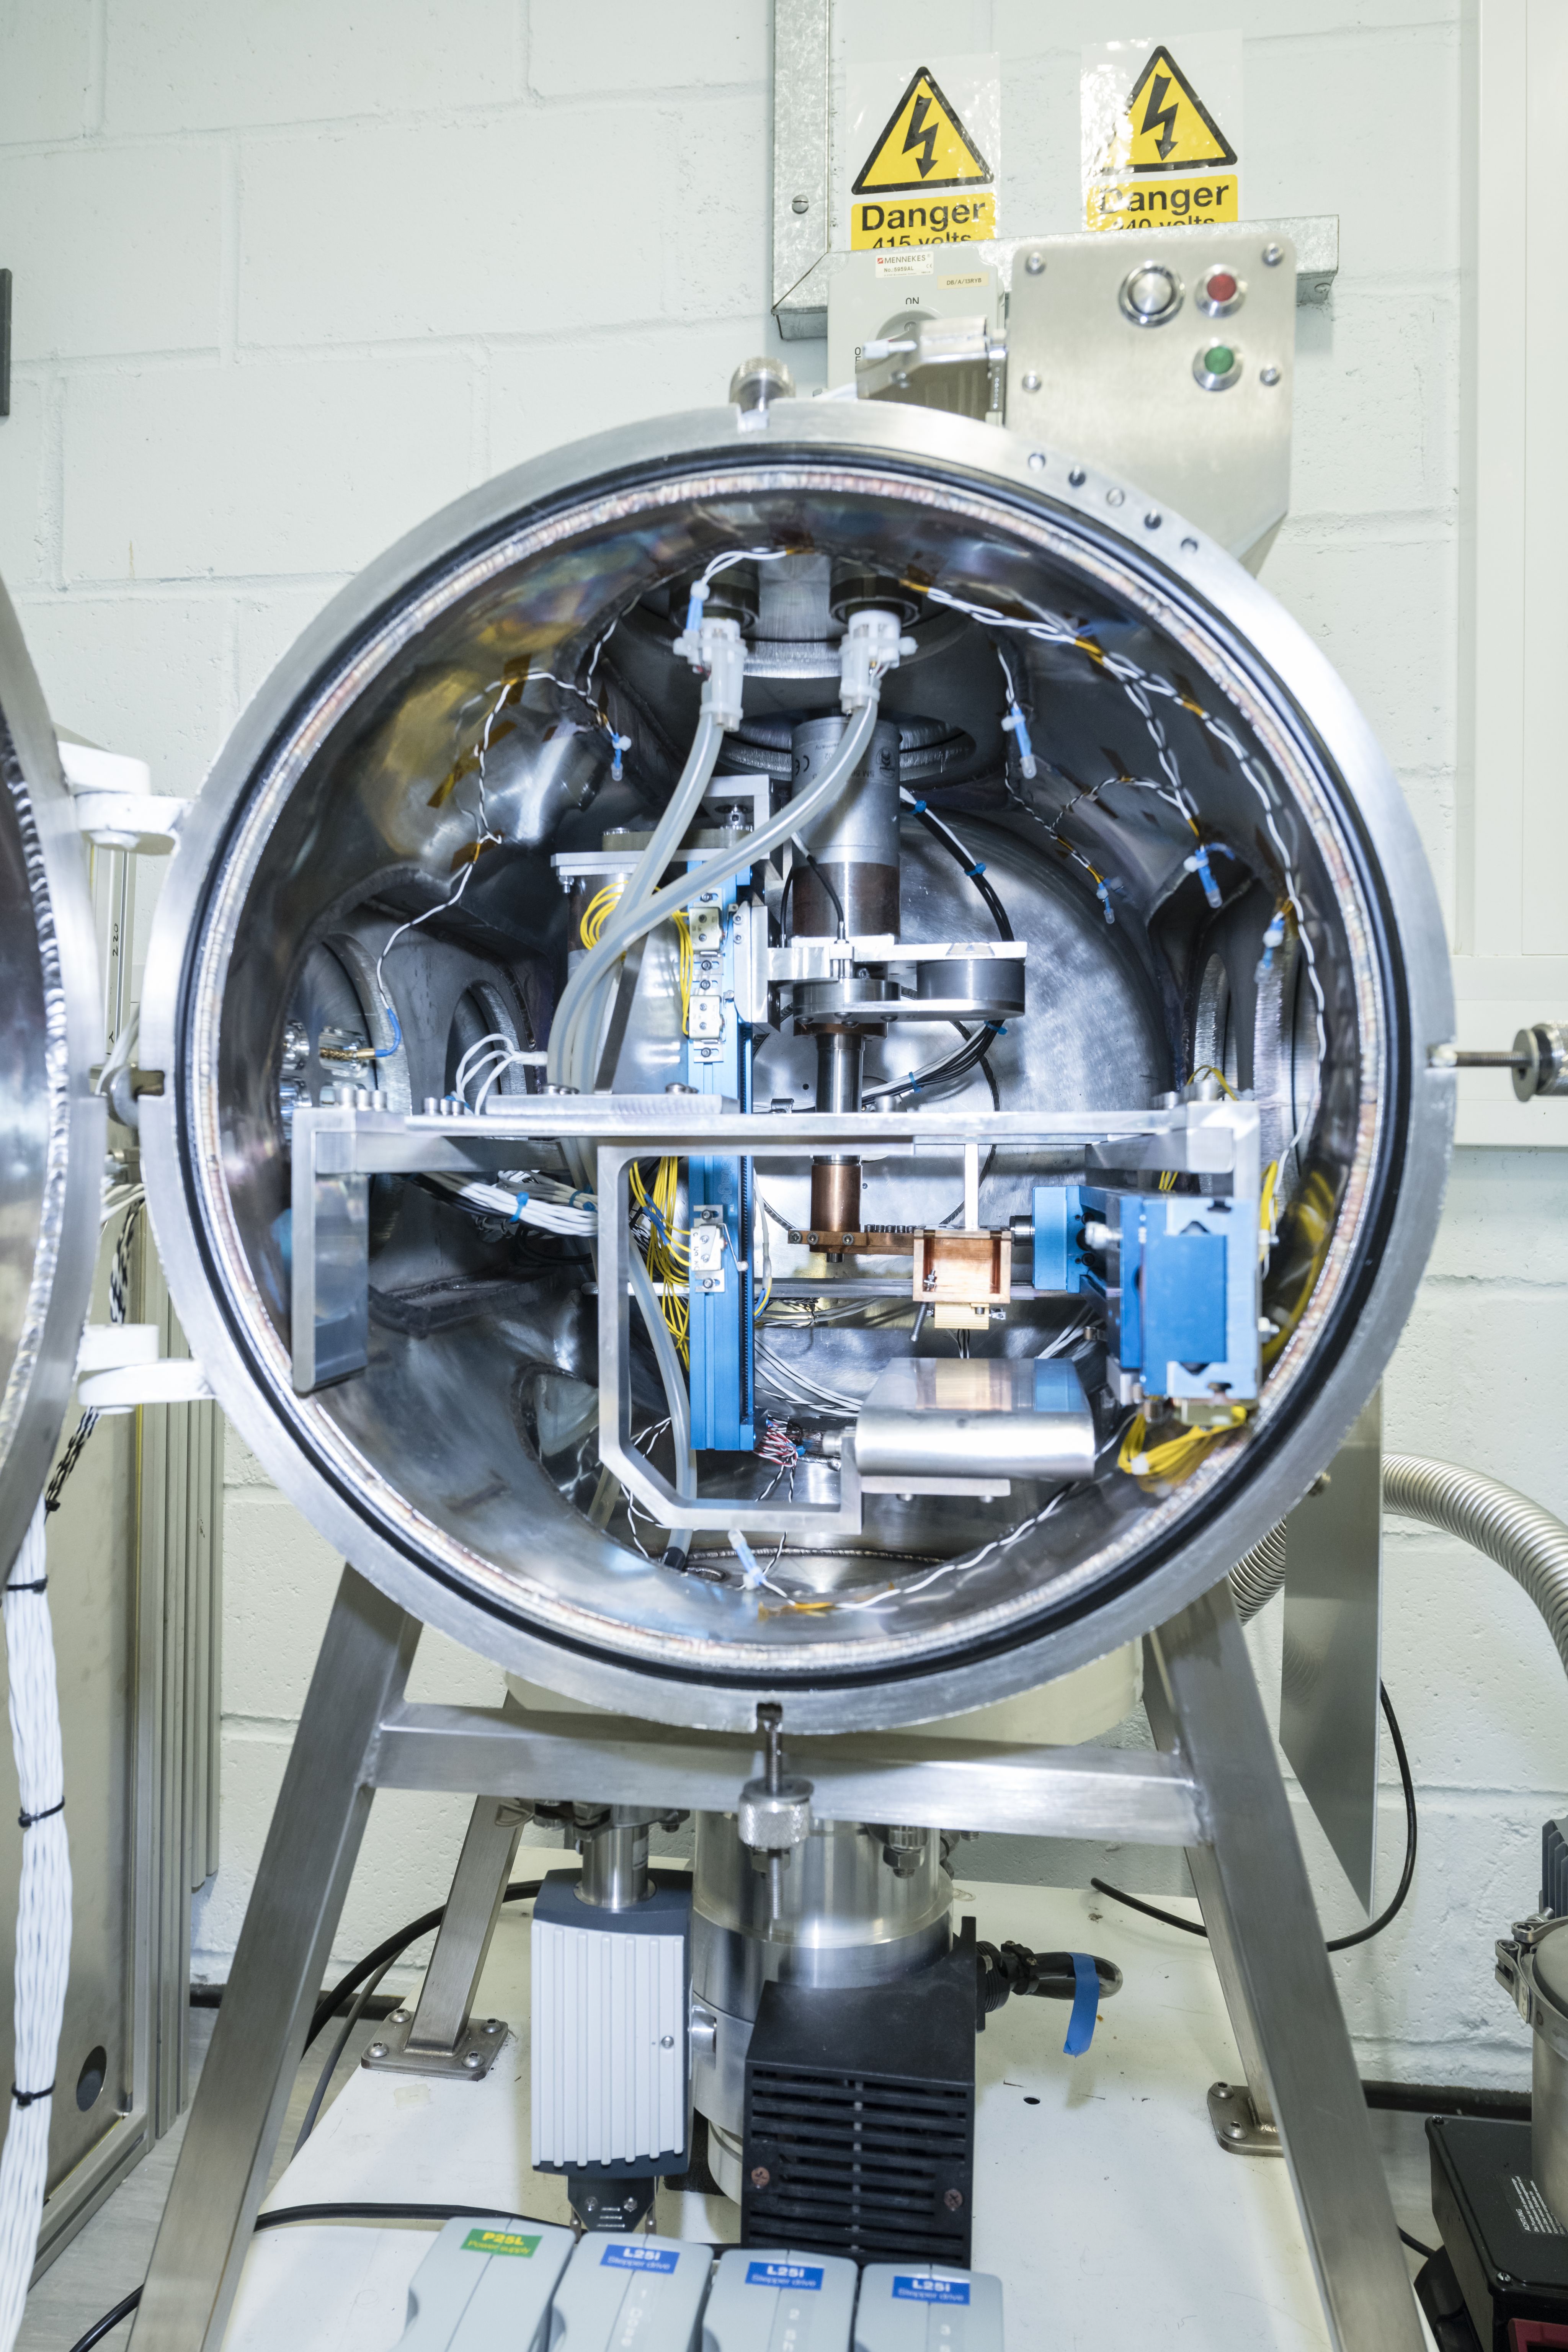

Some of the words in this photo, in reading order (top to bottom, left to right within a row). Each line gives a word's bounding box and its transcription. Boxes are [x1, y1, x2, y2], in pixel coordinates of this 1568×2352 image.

[1099, 185, 1229, 216] Danger
[862, 202, 985, 232] Danger
[885, 255, 926, 264] MENNEKES
[1516, 2209, 1531, 2231] ACHTUNG
[482, 2231, 524, 2246] P25L
[467, 2239, 497, 2250] Power
[498, 2244, 531, 2255] supply
[607, 2256, 645, 2269] Stepper
[646, 2260, 671, 2270] drive
[751, 2273, 790, 2286] Stepper
[792, 2277, 817, 2287] drive
[898, 2288, 937, 2300] Stepper
[939, 2292, 964, 2301] drive
